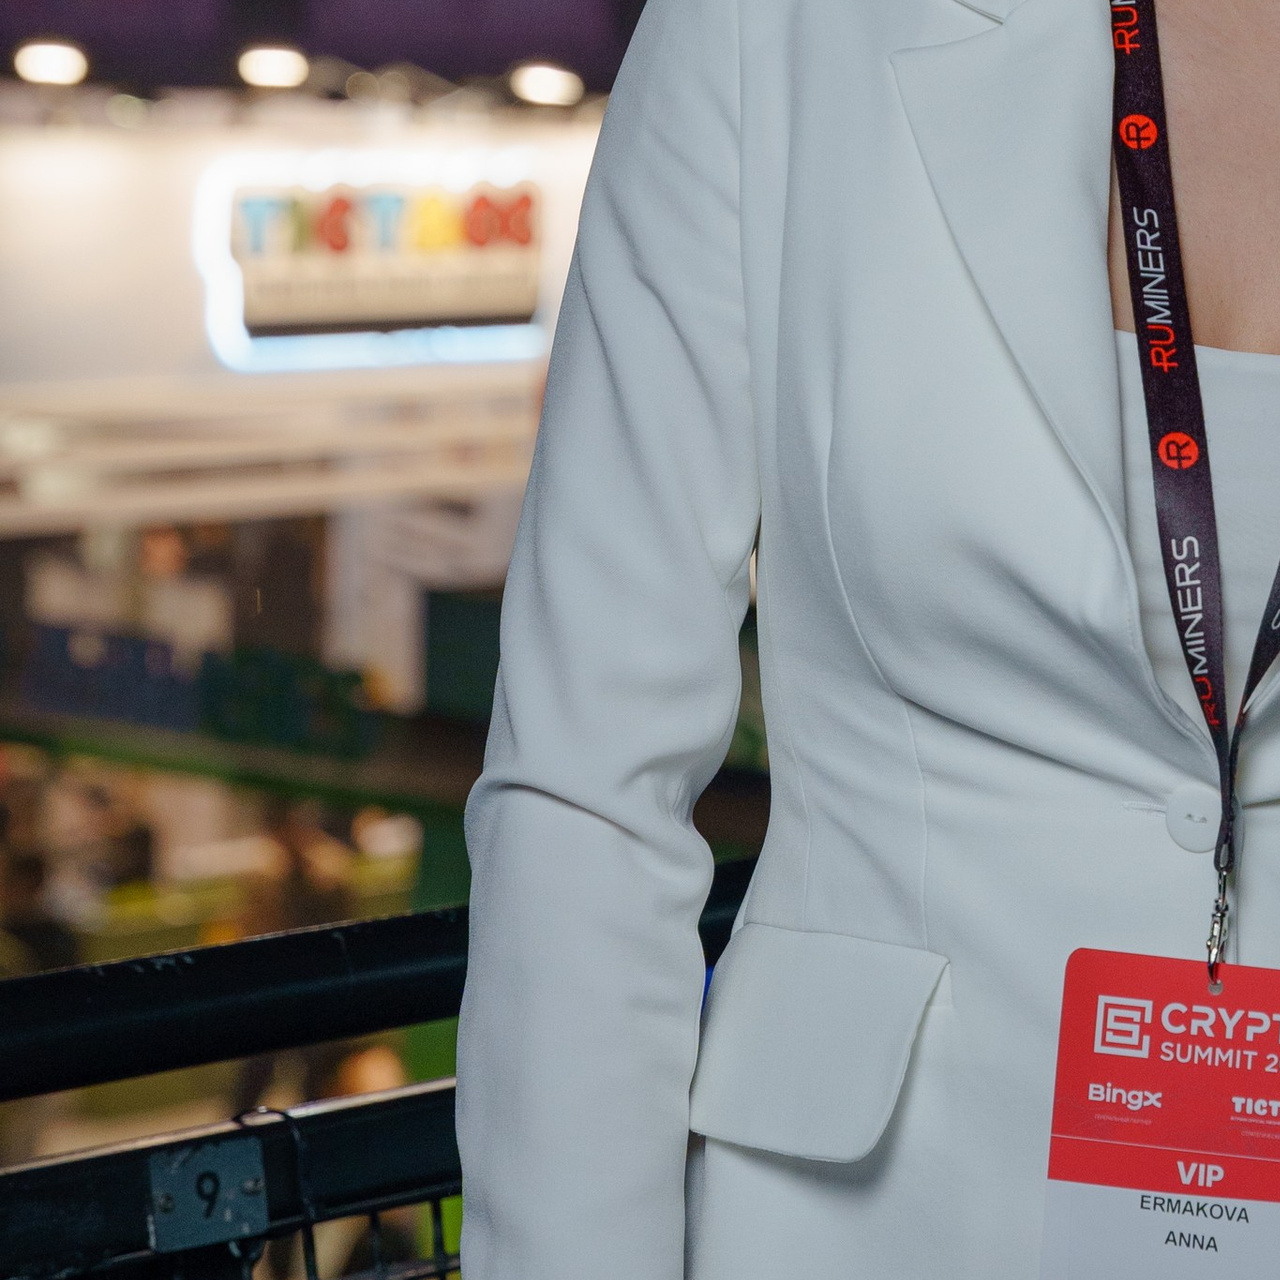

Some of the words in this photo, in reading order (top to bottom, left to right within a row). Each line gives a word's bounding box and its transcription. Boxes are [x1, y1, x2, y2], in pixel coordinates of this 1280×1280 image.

[1133, 206, 1179, 374] RUMINERS
[1160, 1041, 1258, 1070] SUMMIT
[1176, 1160, 1225, 1188] VIP
[1140, 1194, 1250, 1224] ERMAKOVA
[1164, 1230, 1219, 1252] ANNA
